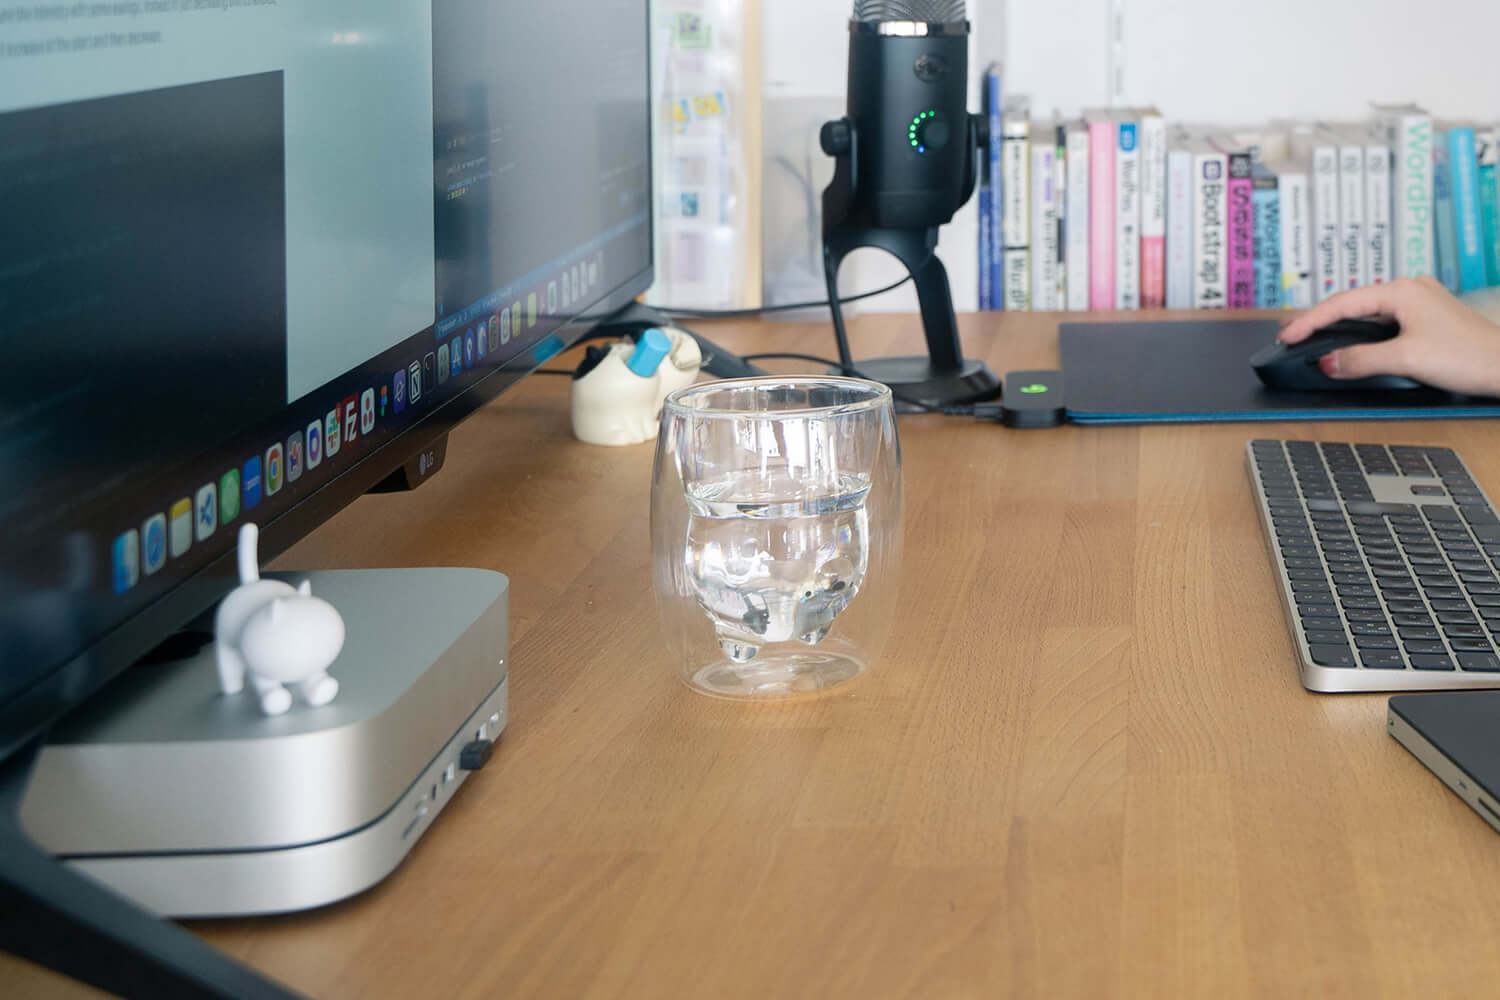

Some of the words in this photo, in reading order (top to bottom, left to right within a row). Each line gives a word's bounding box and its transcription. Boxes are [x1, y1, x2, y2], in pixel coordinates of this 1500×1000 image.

[1198, 184, 1222, 284] Bootstrap
[1233, 185, 1249, 260] Sass
[1265, 199, 1281, 307] WordPres
[1320, 224, 1335, 276] Figma
[1345, 224, 1360, 275] Figma
[1370, 223, 1385, 275] Figma
[1007, 256, 1025, 307] WordP
